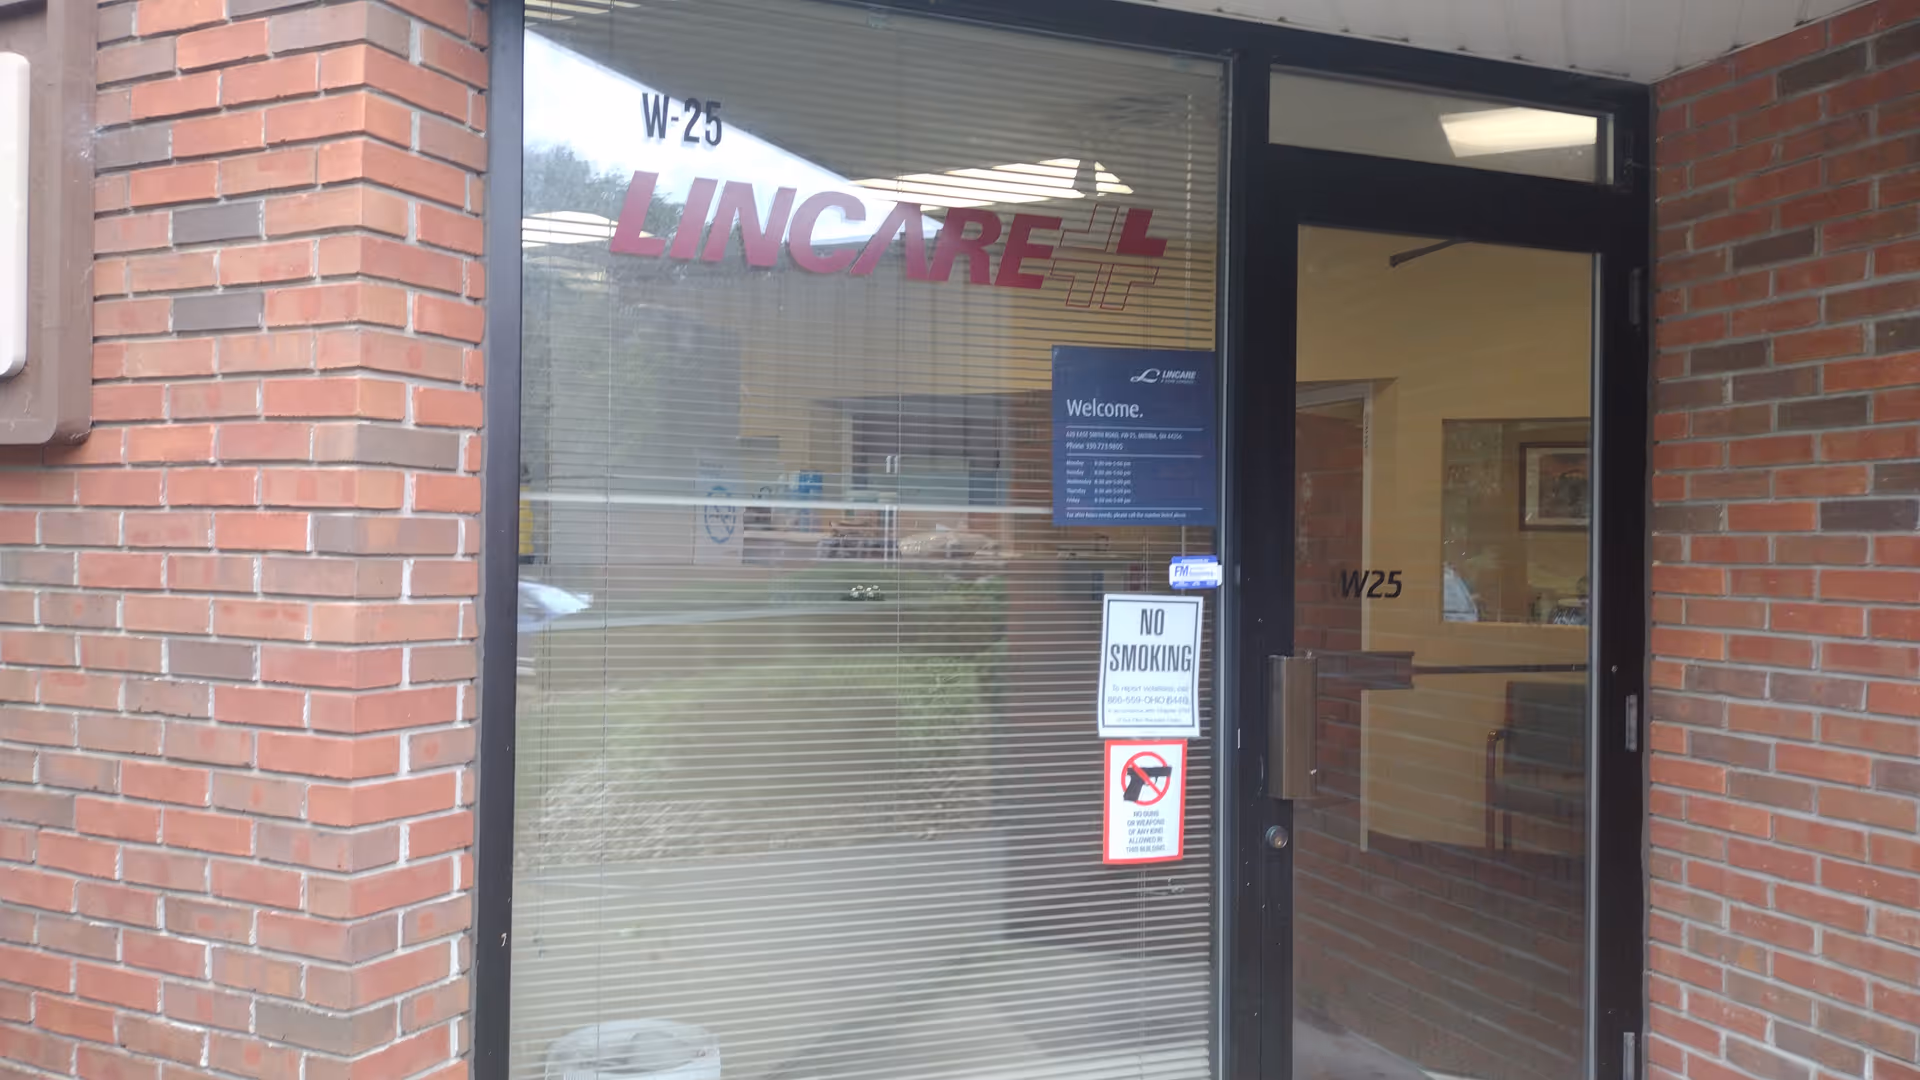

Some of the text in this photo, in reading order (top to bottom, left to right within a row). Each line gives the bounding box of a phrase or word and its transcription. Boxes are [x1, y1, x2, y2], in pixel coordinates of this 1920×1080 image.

[641, 92, 723, 147] W-25
[610, 169, 1062, 290] LINCARE
[1162, 370, 1197, 379] LINCARE
[1066, 398, 1144, 418] Welcome.
[1065, 442, 1084, 450] Phone
[1174, 565, 1189, 577] FM
[1341, 569, 1403, 598] W25
[1140, 608, 1165, 636] NO
[1109, 644, 1192, 672] SMOKING
[1136, 818, 1165, 826] WEAPONS
[1128, 837, 1156, 845] ALLOWED
